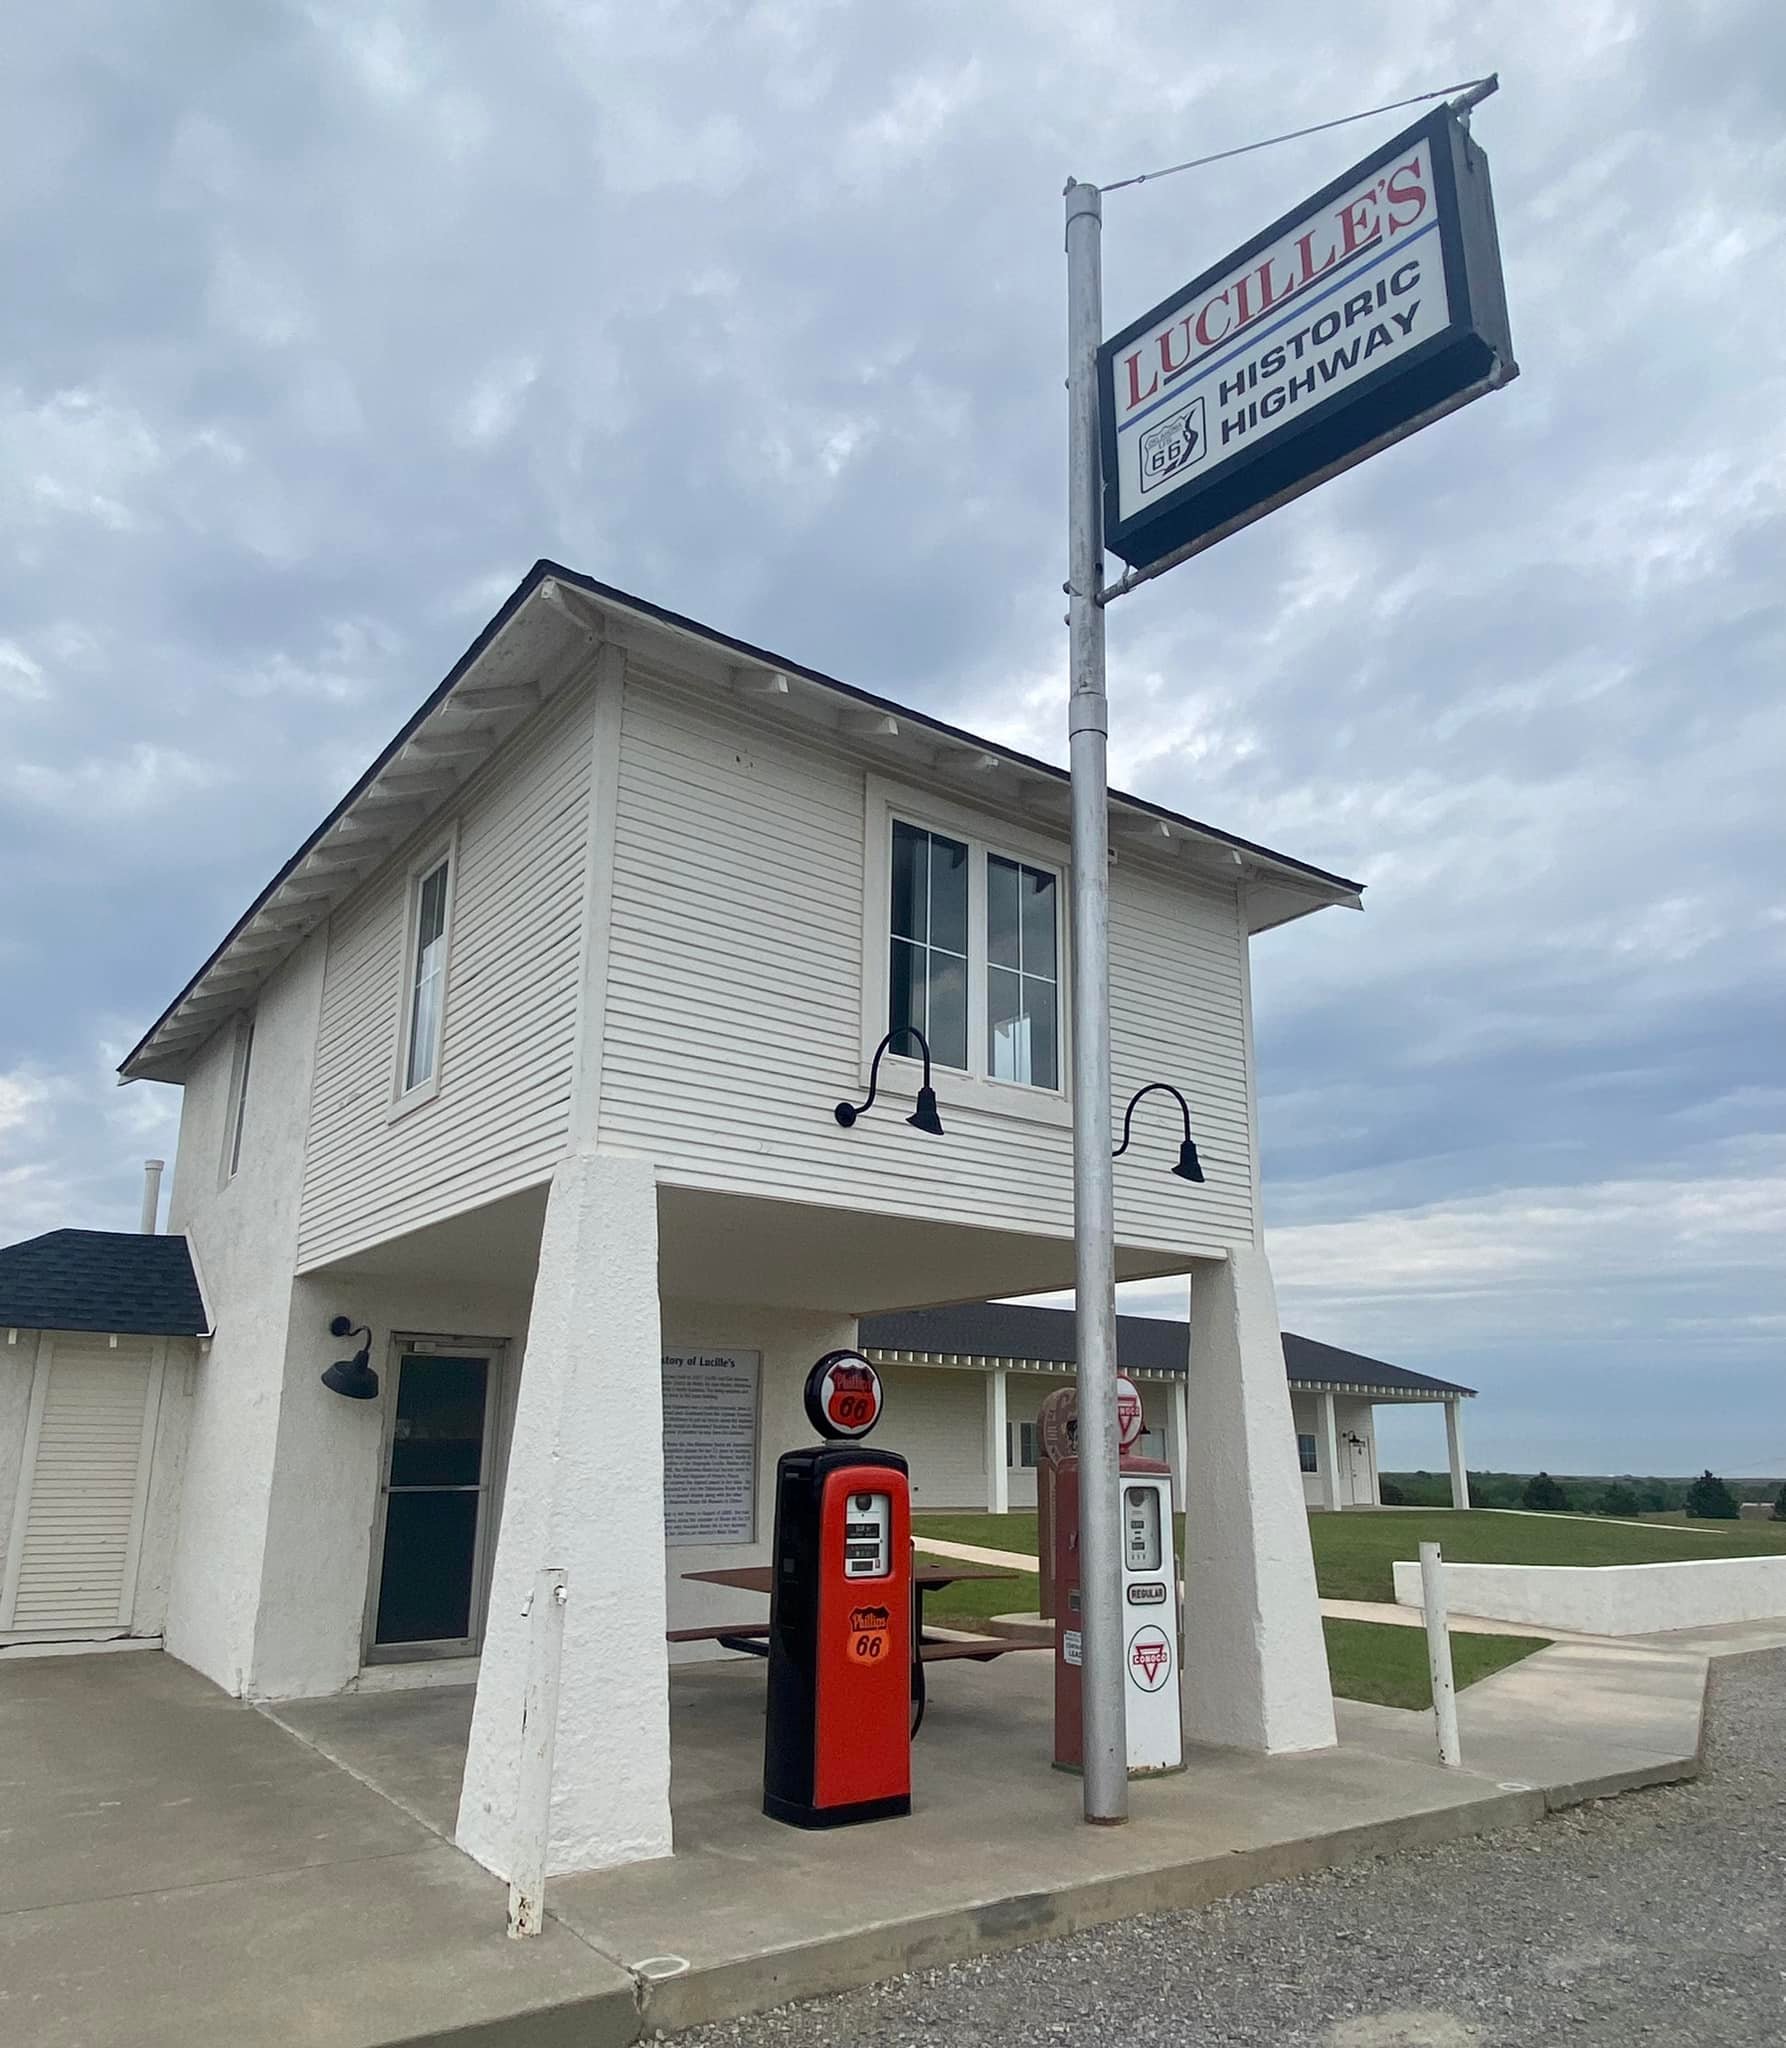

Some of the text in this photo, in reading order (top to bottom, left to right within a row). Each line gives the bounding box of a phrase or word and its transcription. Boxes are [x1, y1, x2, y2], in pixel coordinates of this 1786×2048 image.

[1124, 157, 1427, 410] LUCILLE'S
[1219, 260, 1421, 406] HISTORIC
[1221, 300, 1422, 445] HIGHWAY
[1152, 440, 1181, 471] 66
[687, 1356, 697, 1366] of
[700, 1356, 736, 1368] Lucille's
[840, 1396, 868, 1420] 66
[1118, 1406, 1140, 1416] NOCO
[1131, 1587, 1164, 1600] REGULAR
[856, 1635, 882, 1658] 66
[1133, 1653, 1168, 1665] CONOCO
